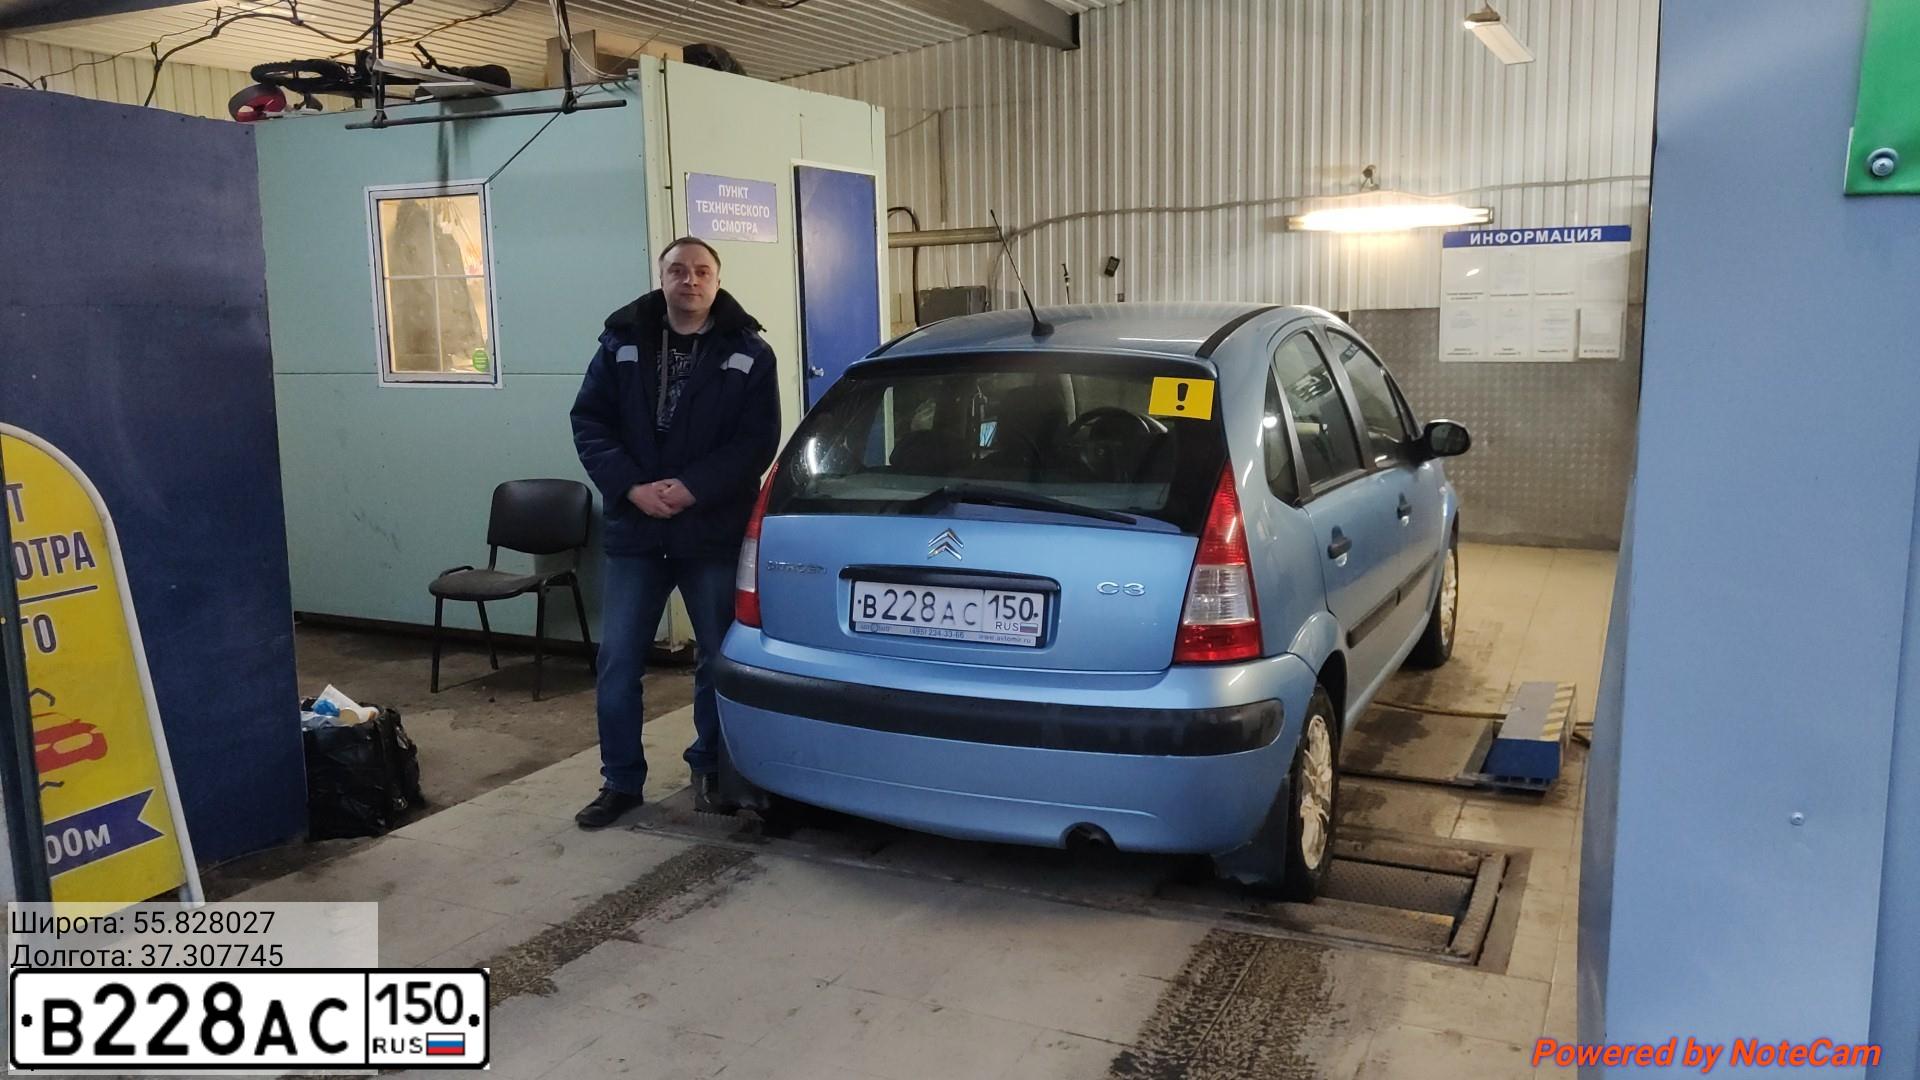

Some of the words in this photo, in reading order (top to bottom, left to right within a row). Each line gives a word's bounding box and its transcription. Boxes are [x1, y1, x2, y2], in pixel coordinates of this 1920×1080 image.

[718, 184, 749, 199] ПУНКТ
[695, 200, 770, 218] ТЕХНИЧЕСКОГО
[711, 219, 758, 234] ОСМОТРА
[1470, 228, 1602, 245] ИНФОРМАЦИЯ
[12, 531, 96, 581] ОТРА
[1096, 581, 1146, 597] C3
[863, 588, 978, 626] В228АС
[988, 594, 1034, 622] 150
[995, 622, 1019, 632] RUS
